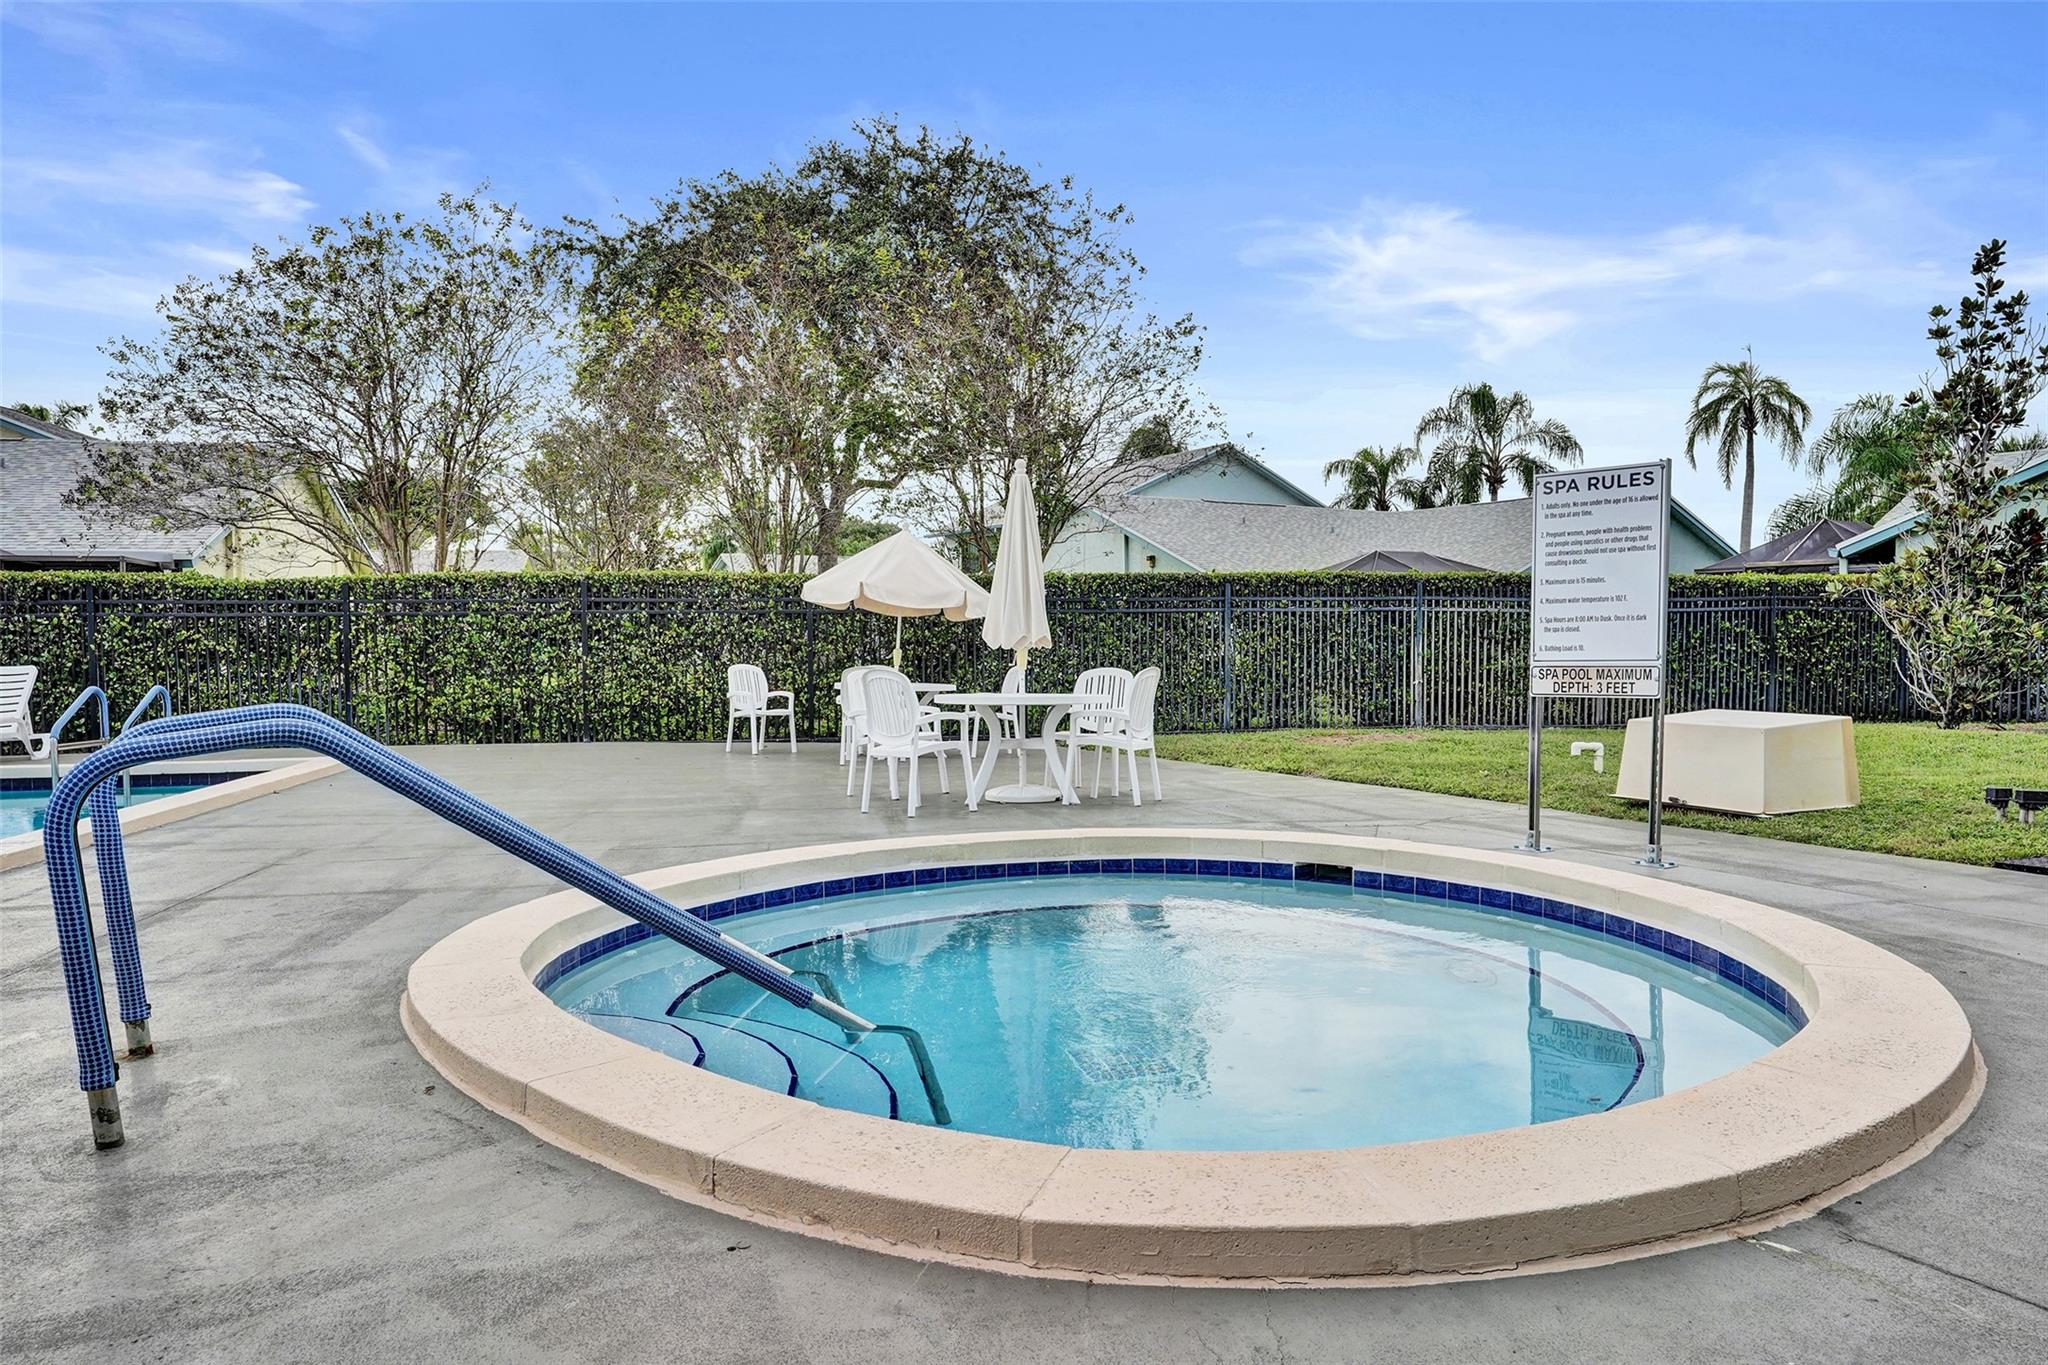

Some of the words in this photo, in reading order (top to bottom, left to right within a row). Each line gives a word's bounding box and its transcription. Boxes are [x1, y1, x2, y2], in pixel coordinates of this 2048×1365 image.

[1543, 478, 1580, 495] SPA
[1588, 471, 1654, 491] RULES
[1639, 494, 1659, 502] allowed
[1581, 595, 1609, 603] temperature
[1538, 668, 1559, 680] SPA
[1562, 669, 1592, 680] POOL
[1596, 669, 1652, 680] MAXIMUM
[1553, 682, 1592, 693] DEPTH:
[1596, 682, 1602, 694] 3
[1606, 682, 1635, 694] FEET
